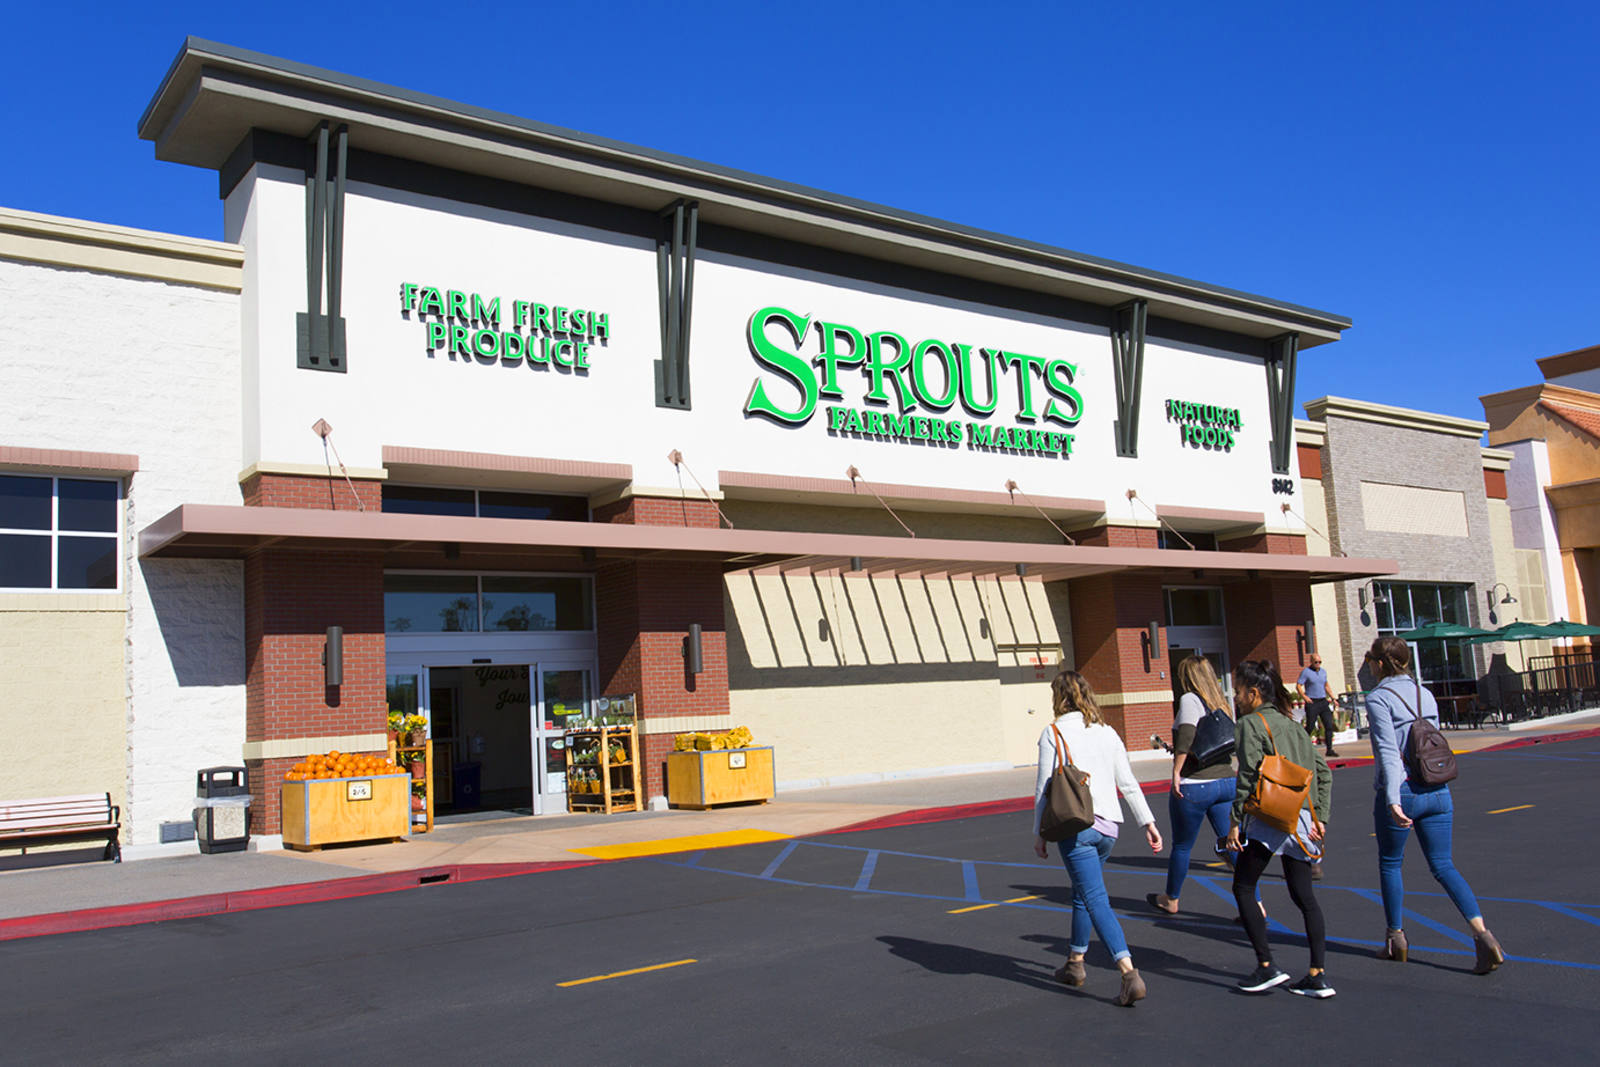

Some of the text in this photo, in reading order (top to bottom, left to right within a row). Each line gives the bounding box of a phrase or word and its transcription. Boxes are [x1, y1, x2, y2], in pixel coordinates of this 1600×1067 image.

[401, 282, 610, 342] FARM FRESH
[426, 321, 591, 371] PRODUCE
[744, 306, 1085, 430] SPROUTS
[827, 406, 1075, 457] FARMERS MARKET
[1166, 399, 1244, 428] NATURAL
[1181, 424, 1235, 449] FOODS
[495, 688, 529, 710] Jou
